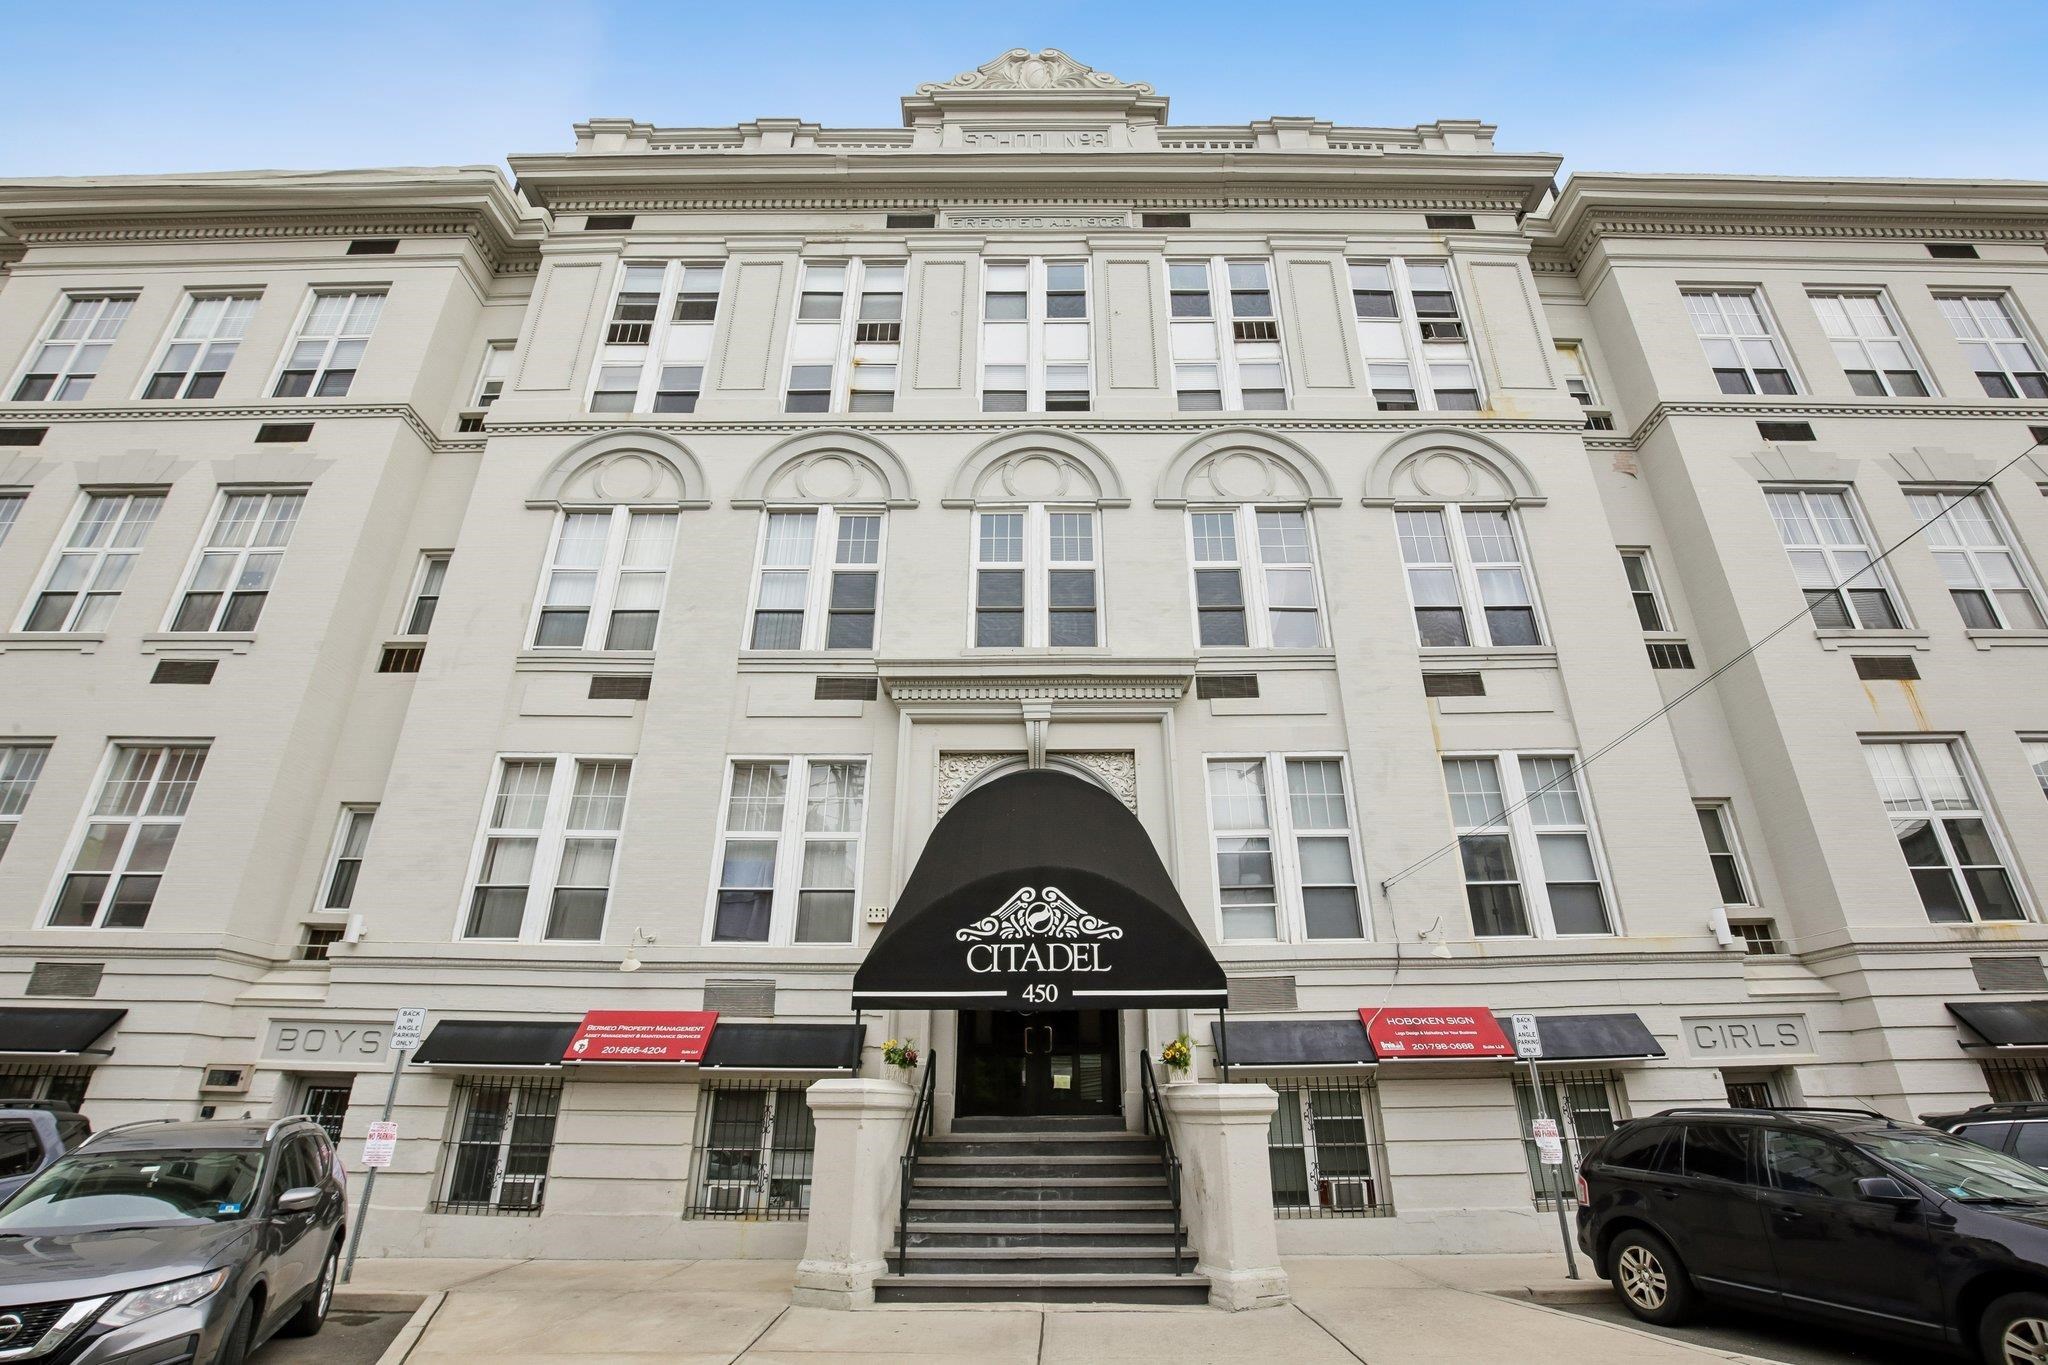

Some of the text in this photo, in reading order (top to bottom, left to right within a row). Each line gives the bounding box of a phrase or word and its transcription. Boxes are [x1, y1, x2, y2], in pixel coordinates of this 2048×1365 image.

[951, 217, 1045, 228] ERECTED
[966, 943, 1112, 973] CITADEL
[1022, 983, 1059, 1003] 450
[1387, 1017, 1475, 1025] HOBOKEN SIGN
[276, 1028, 382, 1053] BOYS
[1694, 1023, 1800, 1049] GIRLS
